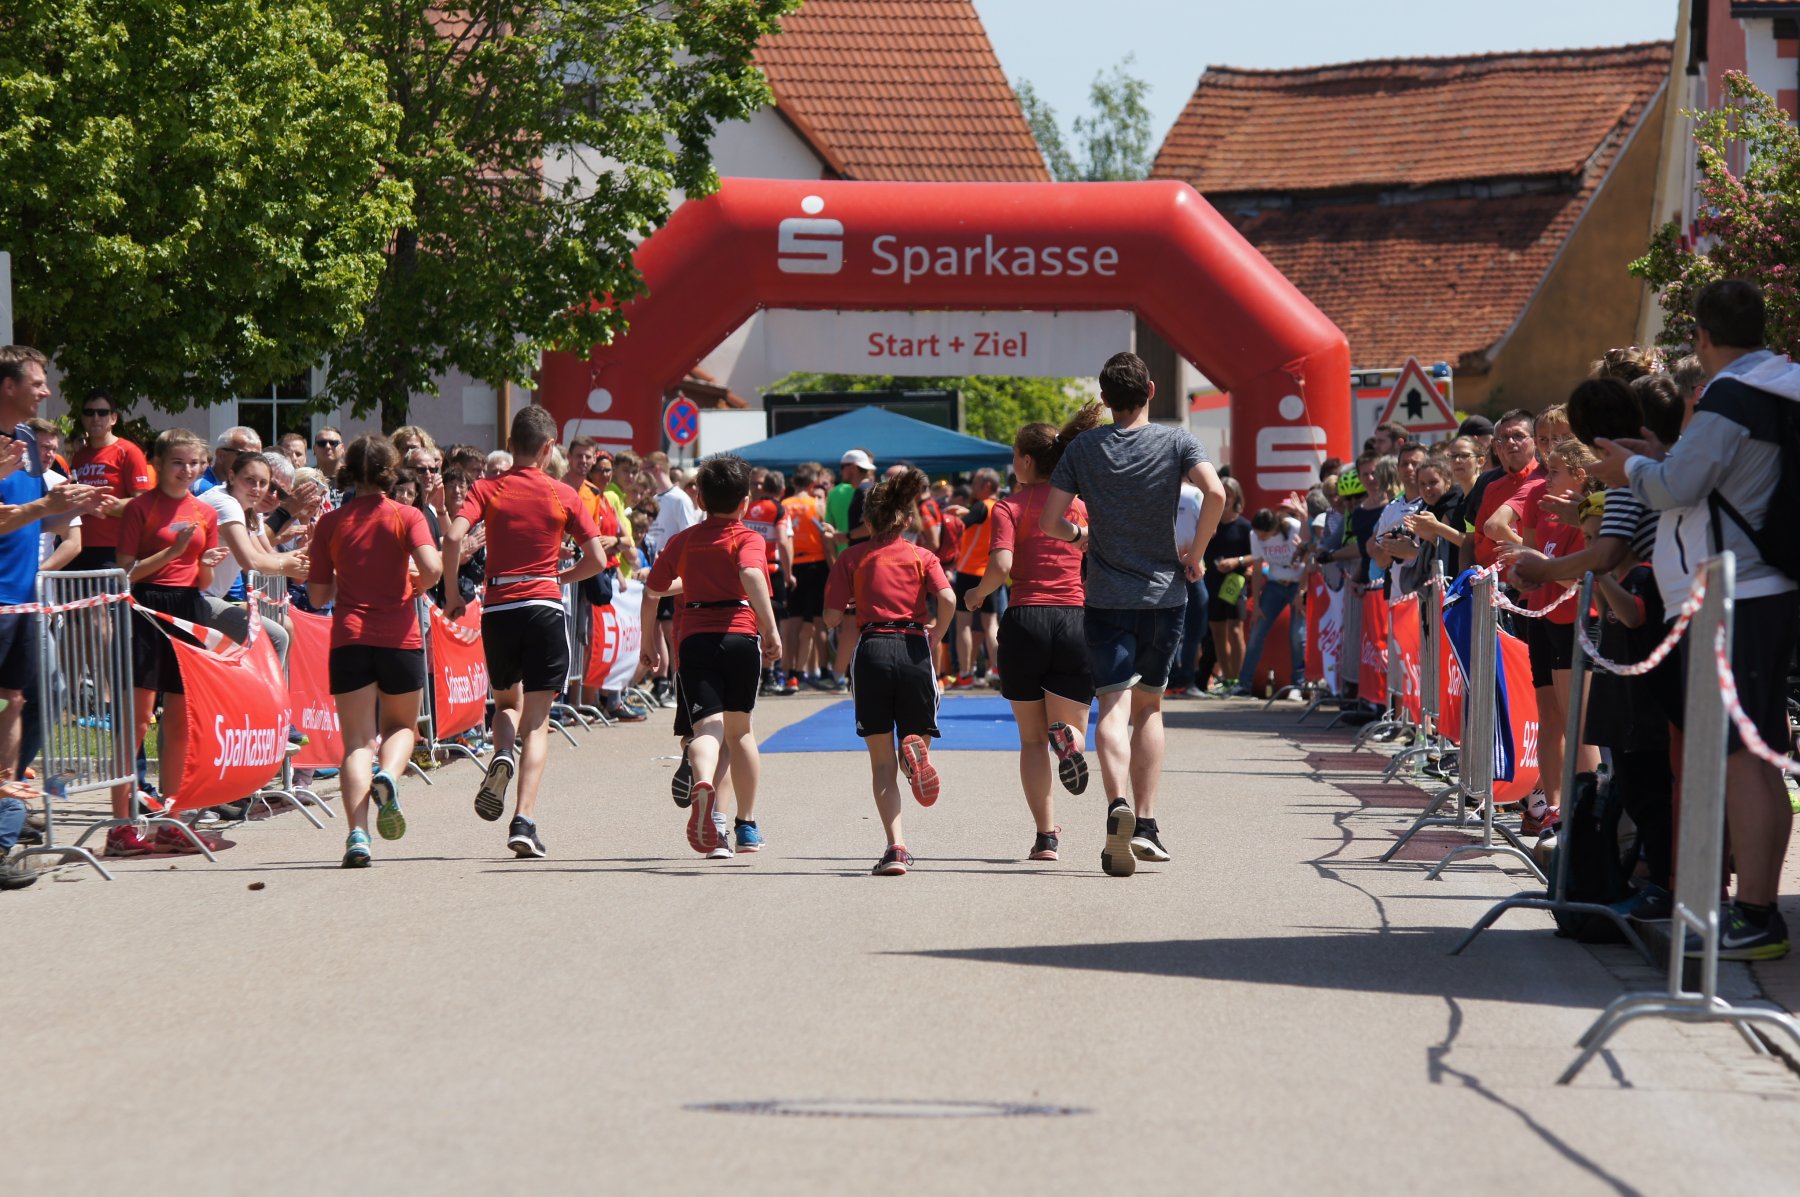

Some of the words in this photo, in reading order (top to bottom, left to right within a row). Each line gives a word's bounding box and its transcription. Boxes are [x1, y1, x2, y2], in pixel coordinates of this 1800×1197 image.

[871, 233, 1119, 284] Sparkasse
[867, 332, 940, 357] Start
[973, 331, 1028, 357] Ziel
